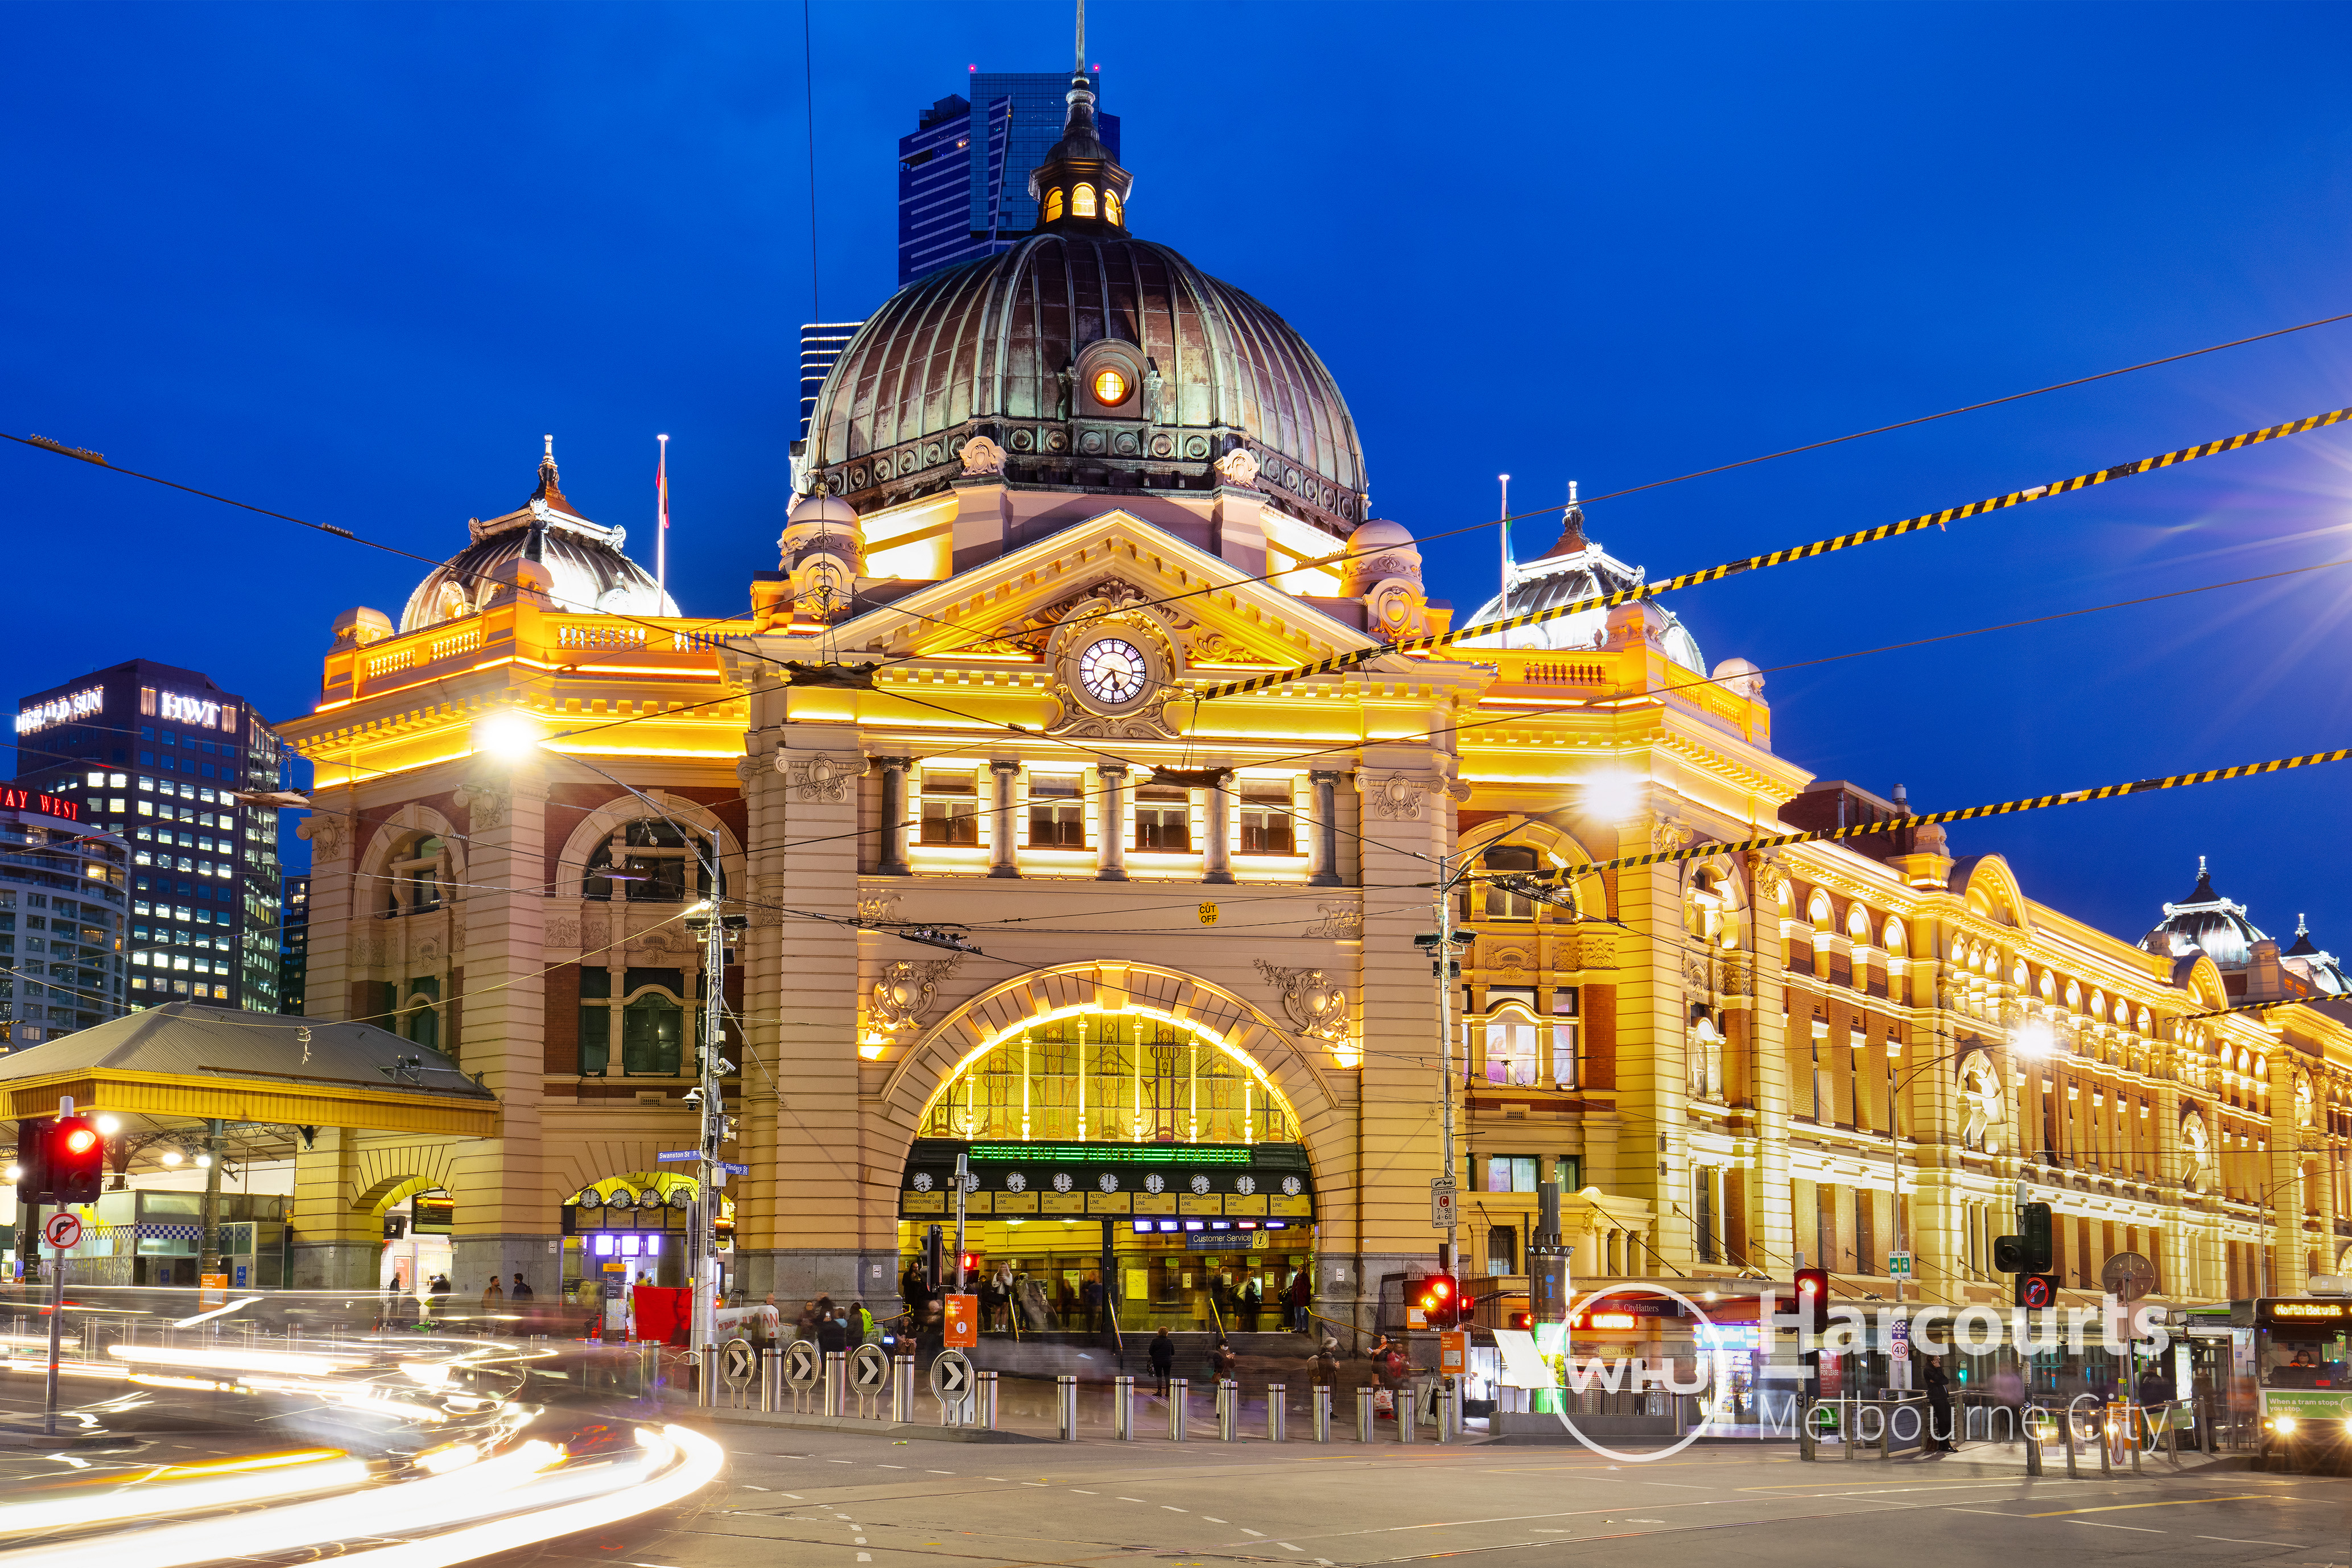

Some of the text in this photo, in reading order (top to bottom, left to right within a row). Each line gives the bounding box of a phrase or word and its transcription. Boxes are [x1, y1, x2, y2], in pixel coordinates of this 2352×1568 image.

[15, 690, 102, 732] HERALD SUN
[162, 691, 220, 725] HWT
[40, 794, 78, 820] WEST
[1199, 905, 1216, 914] CUT
[1200, 914, 1216, 923] OFF
[971, 1145, 1249, 1162] FLINDERS STREET STATION
[1193, 1234, 1225, 1243] Customer
[718, 1319, 737, 1332] B'DAY
